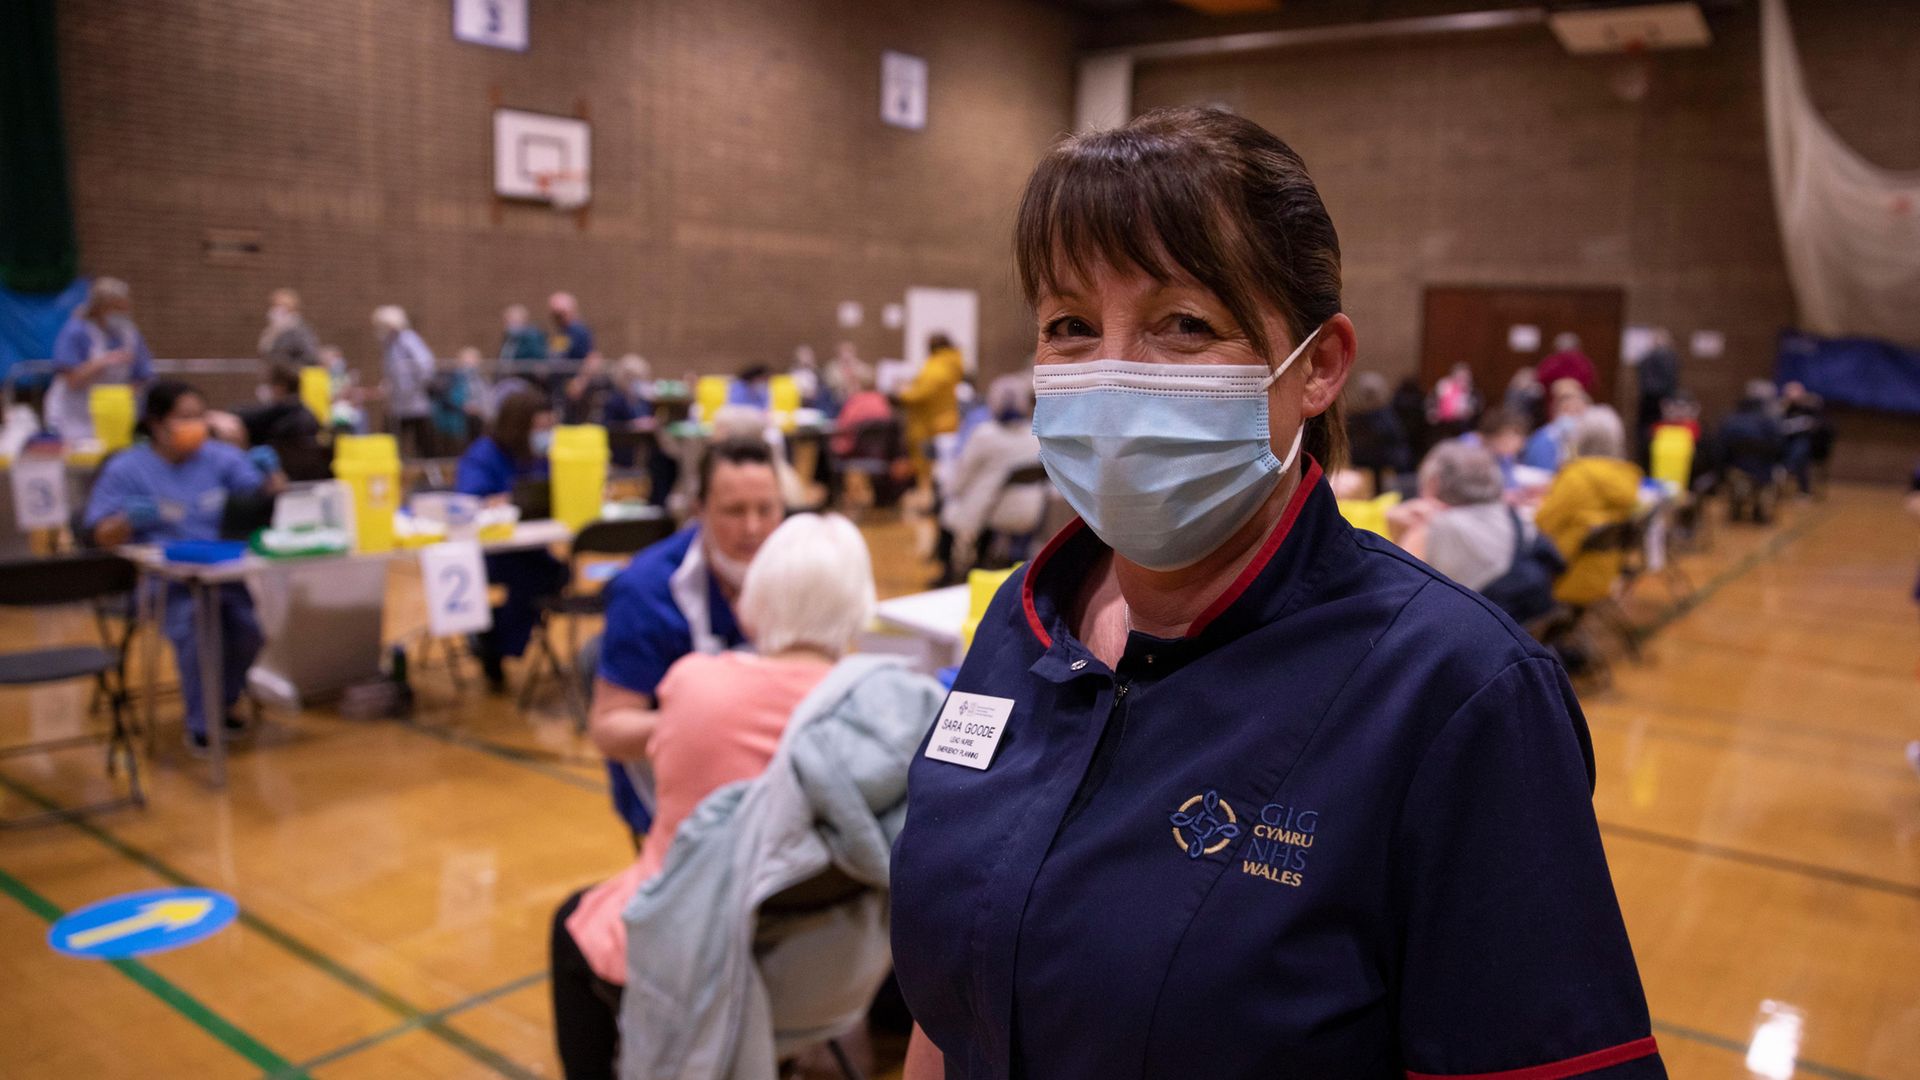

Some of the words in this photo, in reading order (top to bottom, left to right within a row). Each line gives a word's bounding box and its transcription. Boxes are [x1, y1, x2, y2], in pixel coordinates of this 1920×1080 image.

[438, 564, 475, 614] 2
[941, 718, 962, 732] SARA
[964, 722, 996, 738] GOODE
[1261, 803, 1319, 833] GIG
[1253, 824, 1314, 848] CYMRU
[1246, 838, 1308, 871] NHS
[1242, 860, 1304, 887] WALES
